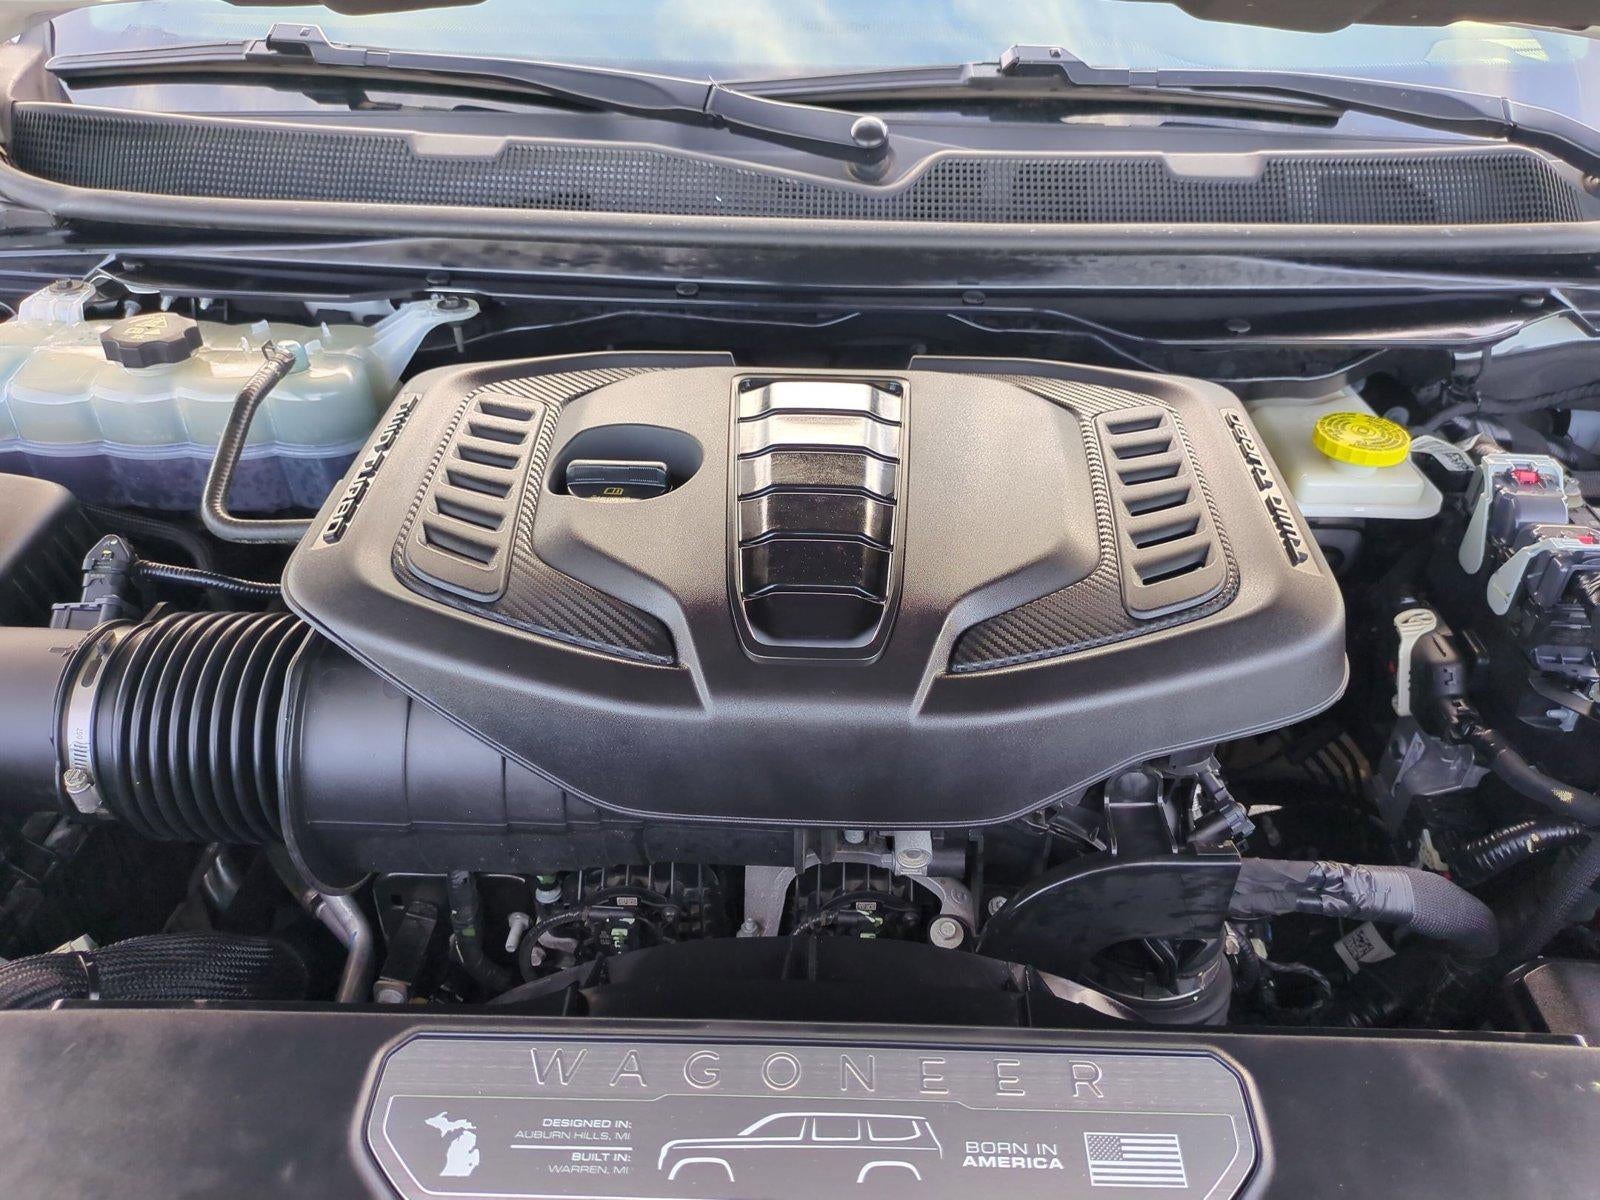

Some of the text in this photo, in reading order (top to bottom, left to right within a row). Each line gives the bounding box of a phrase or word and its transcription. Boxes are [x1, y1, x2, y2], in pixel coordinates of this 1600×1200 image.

[1225, 412, 1273, 492] TURBO
[322, 452, 385, 544] TURBO
[529, 1047, 1105, 1098] WAGONEER
[542, 1118, 632, 1129] DESIGNED IN:
[514, 1129, 631, 1141] AUBURN HILLS, MI
[965, 1141, 1058, 1156] BORN IN
[571, 1151, 631, 1162] BUILT IN:
[962, 1155, 1065, 1170] AMERICA
[548, 1164, 629, 1175] WARREN, MI
